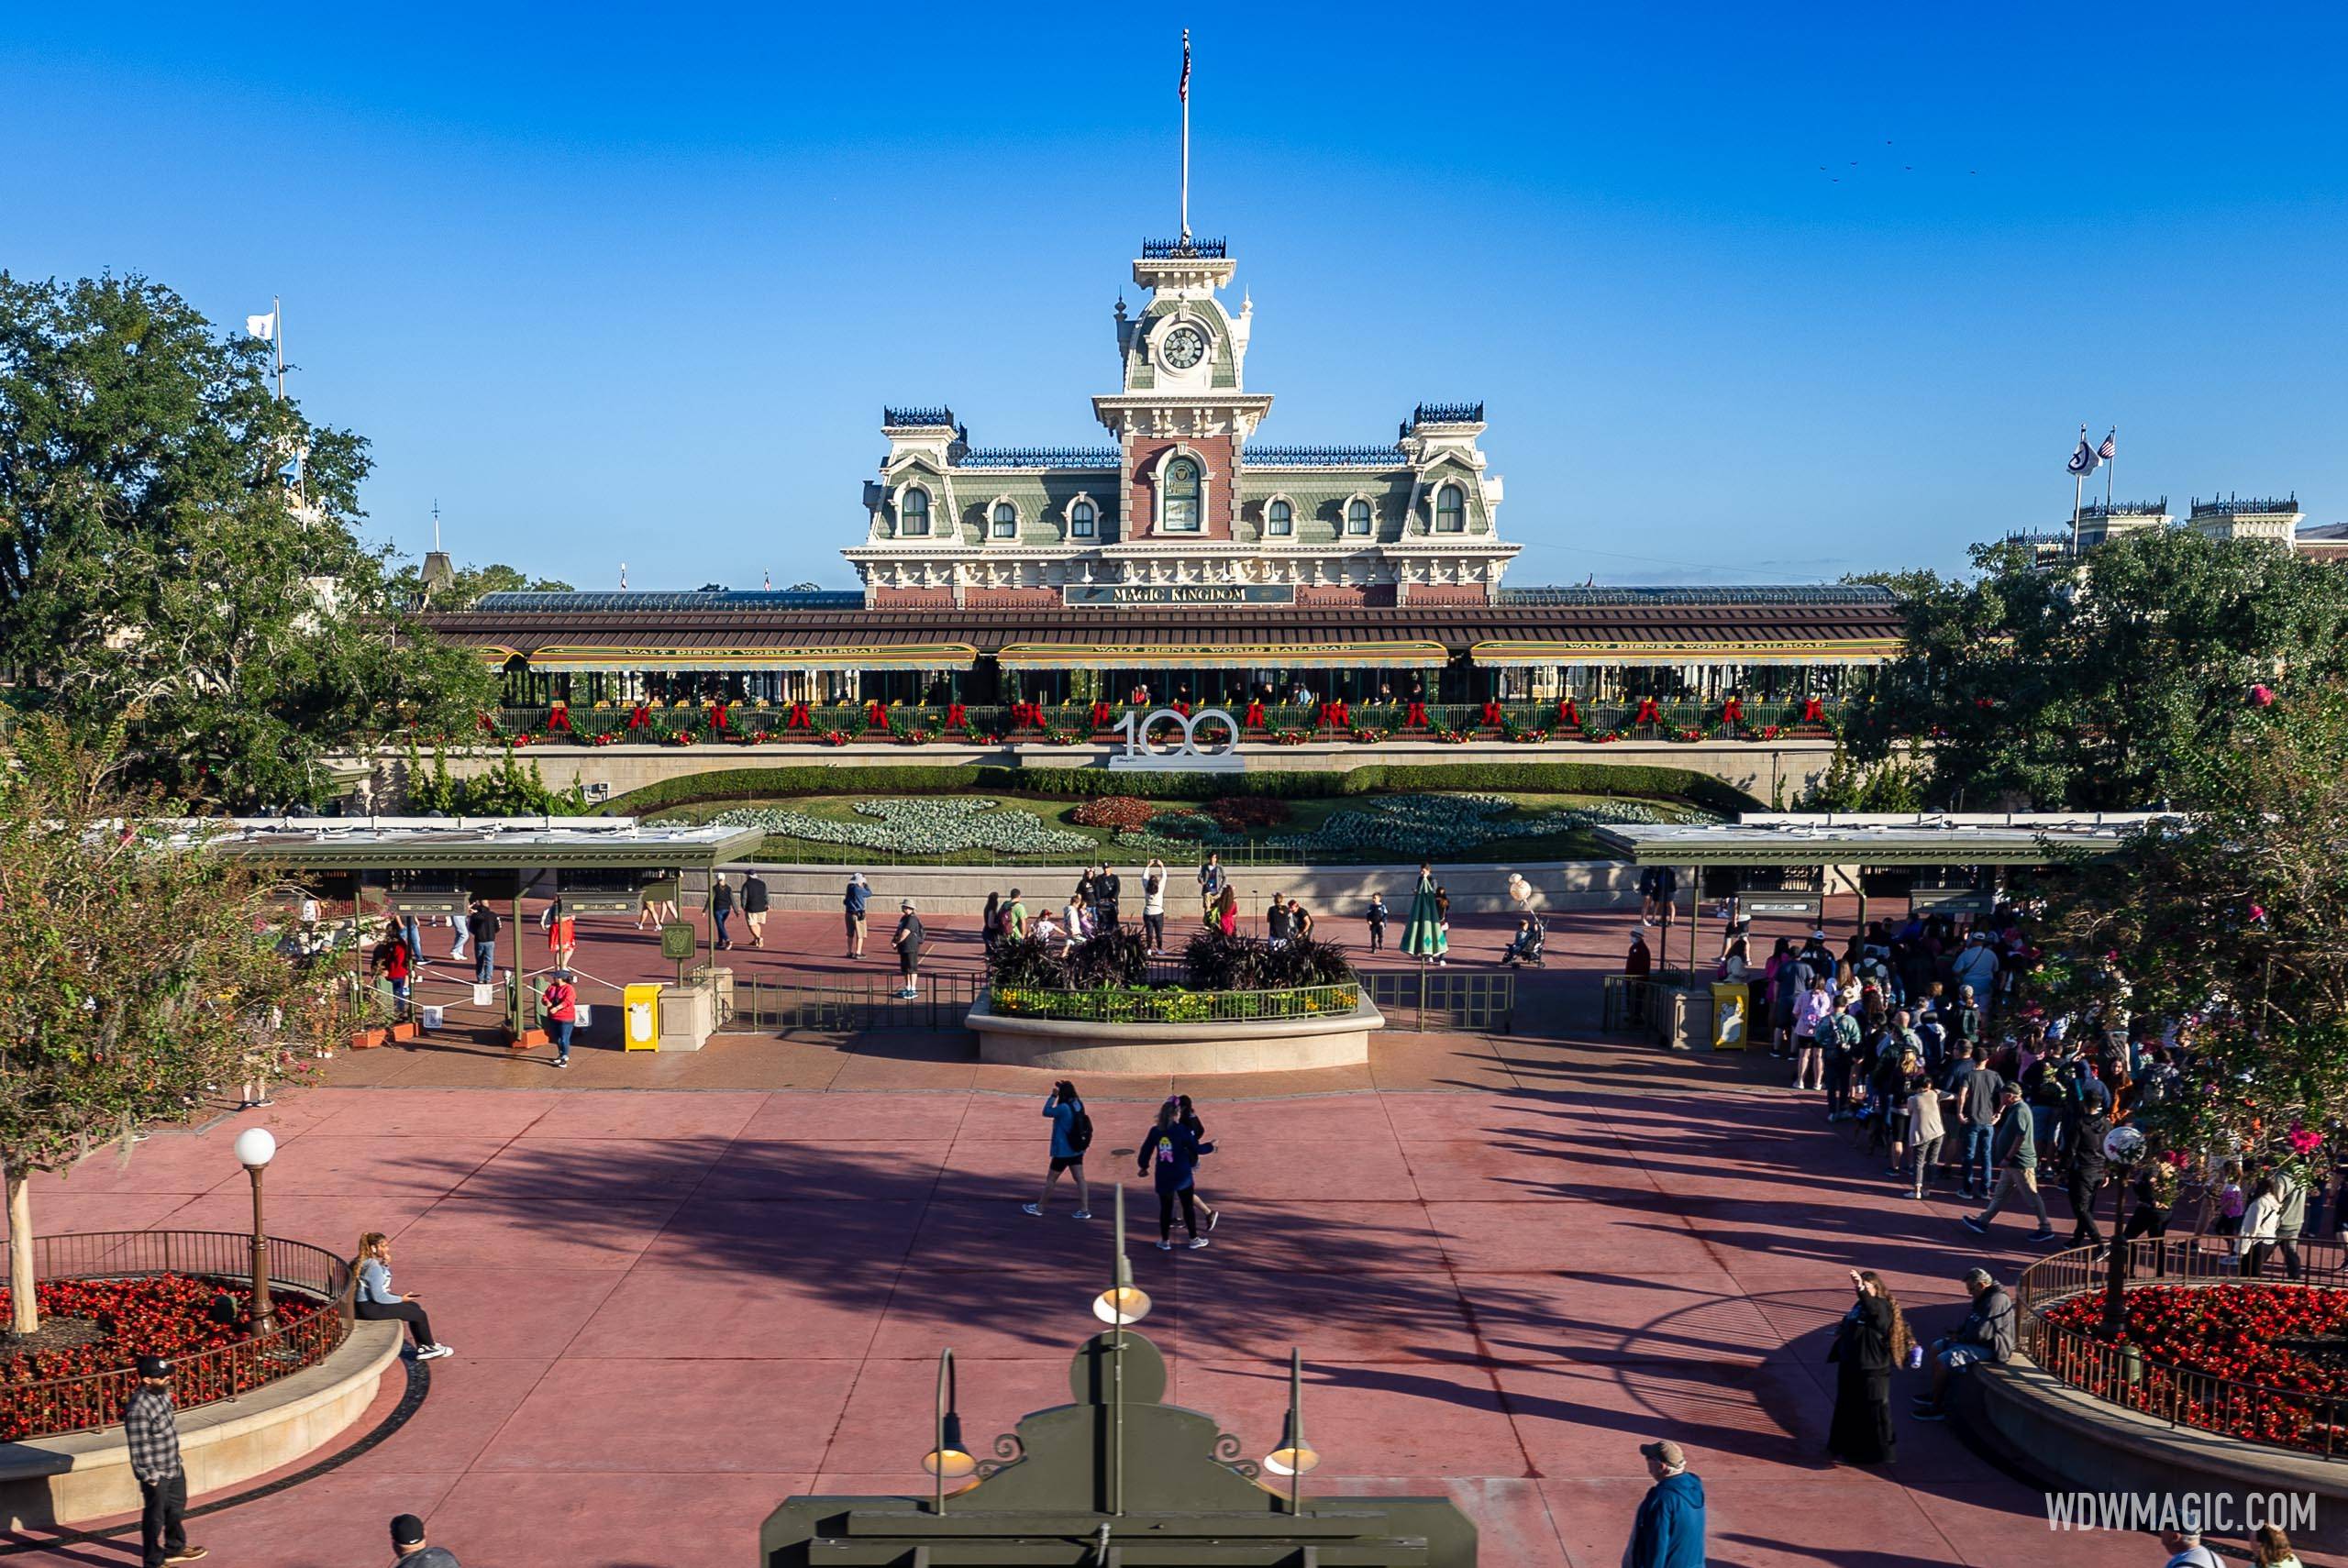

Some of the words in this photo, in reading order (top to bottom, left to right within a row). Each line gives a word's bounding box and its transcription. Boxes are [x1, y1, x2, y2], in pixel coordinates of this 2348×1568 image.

[1113, 587, 1166, 602] MAGIC
[1171, 587, 1246, 602] KINGDOM
[1113, 709, 1239, 756] 100
